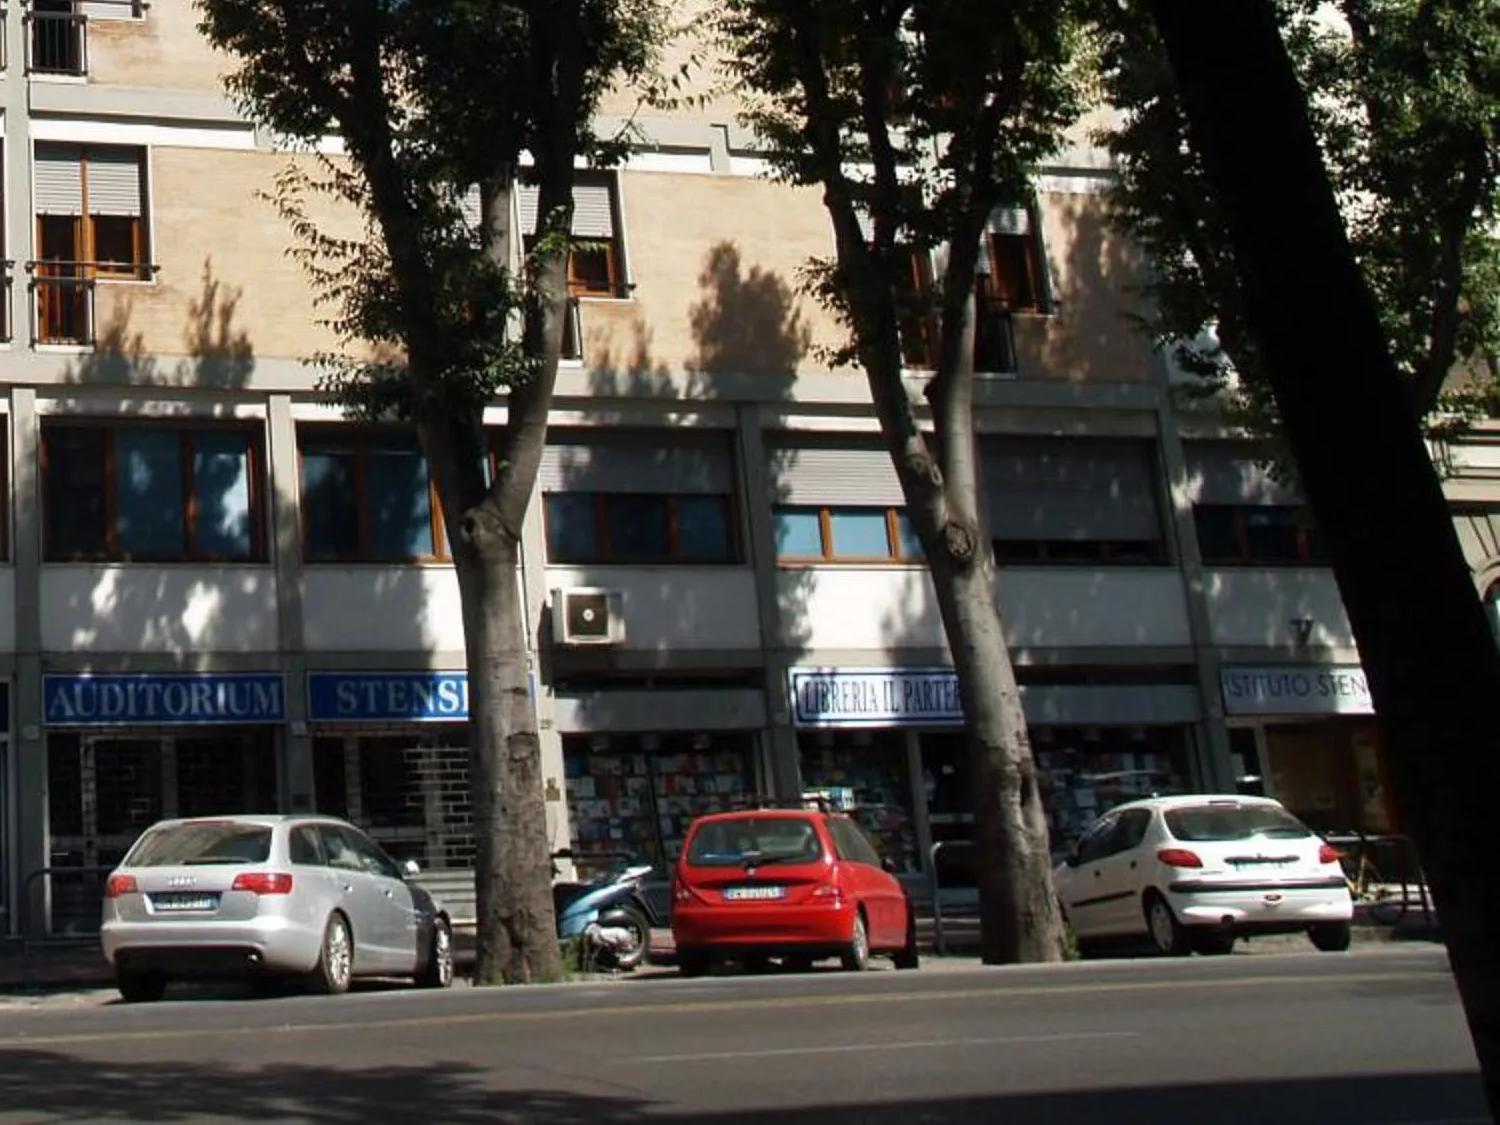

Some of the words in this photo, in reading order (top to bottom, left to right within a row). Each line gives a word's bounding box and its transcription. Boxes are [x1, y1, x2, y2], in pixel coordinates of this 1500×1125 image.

[49, 680, 280, 717] AUDITORIUM
[804, 680, 878, 713] LIBRERIA
[883, 680, 899, 712] IL
